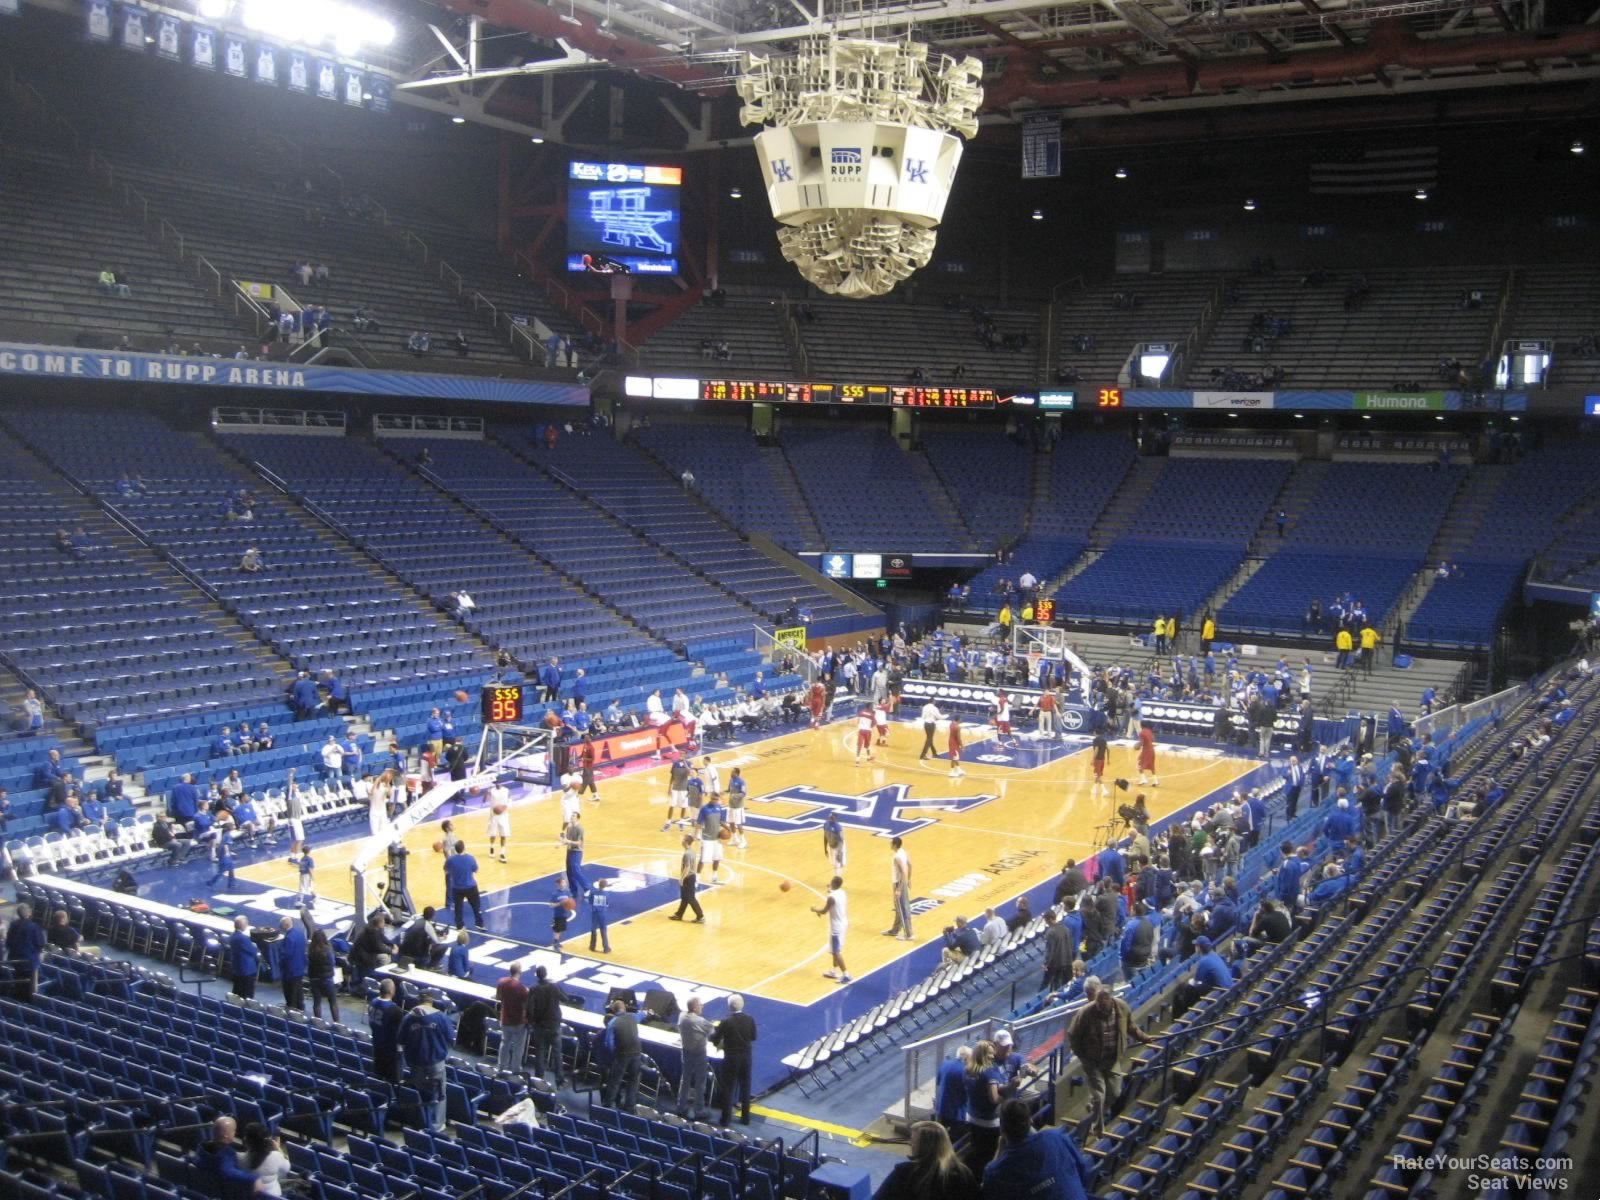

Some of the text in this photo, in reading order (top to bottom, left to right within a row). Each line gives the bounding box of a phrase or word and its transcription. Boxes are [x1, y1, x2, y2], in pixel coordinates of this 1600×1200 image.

[831, 165, 862, 175] RUPP
[100, 358, 132, 377] TO
[148, 361, 217, 381] RUPP
[229, 367, 305, 387] ARENA
[1099, 390, 1119, 407] 35
[1230, 398, 1261, 408] verizon
[495, 688, 519, 700] 5:55
[492, 700, 516, 720] 35
[980, 850, 1047, 875] ARENA
